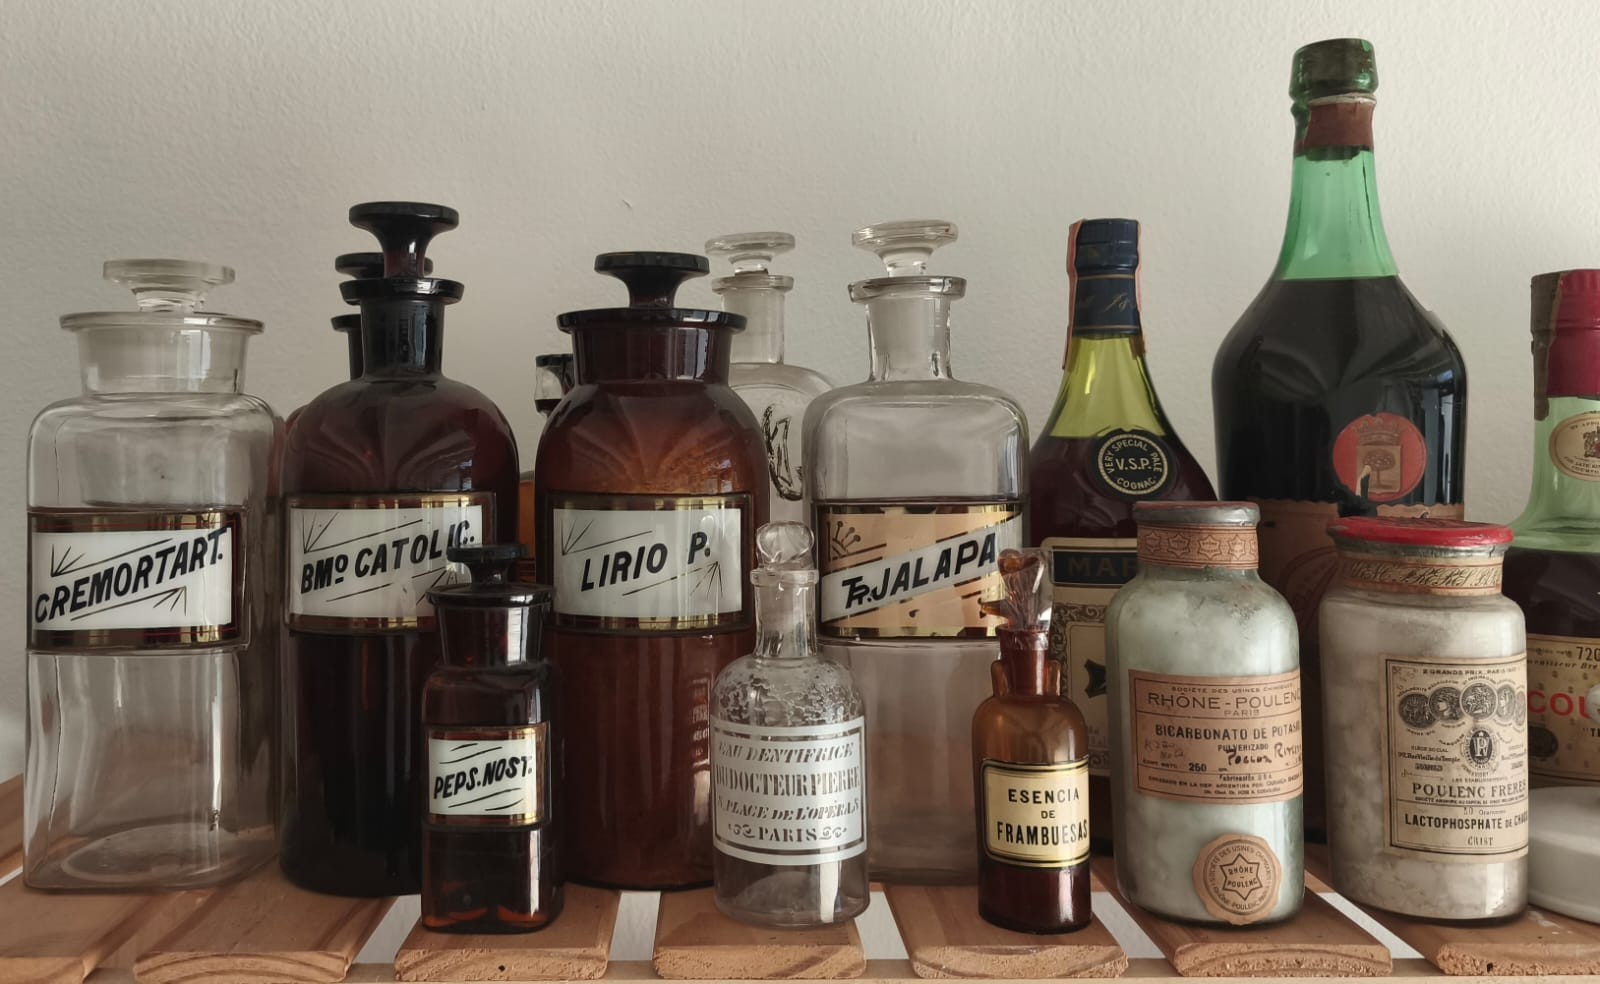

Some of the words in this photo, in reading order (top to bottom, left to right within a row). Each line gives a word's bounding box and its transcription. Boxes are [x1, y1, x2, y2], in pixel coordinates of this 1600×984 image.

[1104, 450, 1115, 474] VERY
[1111, 439, 1149, 452] SPECIAL
[1150, 451, 1162, 473] PALE
[1116, 477, 1157, 490] COGNAC
[581, 543, 668, 592] LIRIO
[687, 531, 711, 565] P.
[35, 527, 228, 623] CREMORTART.
[1224, 709, 1260, 717] PARIS
[1155, 723, 1248, 741] BICARBONATO
[1253, 728, 1268, 740] DE
[718, 742, 744, 758] EAU
[746, 742, 855, 763] DENTIFRICE
[715, 763, 730, 786] DU
[730, 767, 808, 797] DOCTEUR
[811, 765, 860, 797] PIERRE
[1008, 787, 1079, 804] ESENCIA
[1412, 782, 1486, 799] POULENC
[726, 799, 769, 819] PLACE
[771, 809, 794, 821] DE
[1041, 810, 1056, 819] DE
[1404, 813, 1502, 830] LACTOPHOSPHATE
[1505, 818, 1513, 828] DE
[759, 826, 818, 843] PARIS
[997, 819, 1088, 846] FRAMBUESAS
[1228, 866, 1254, 876] RHÔNE
[1227, 877, 1258, 889] POULENC
